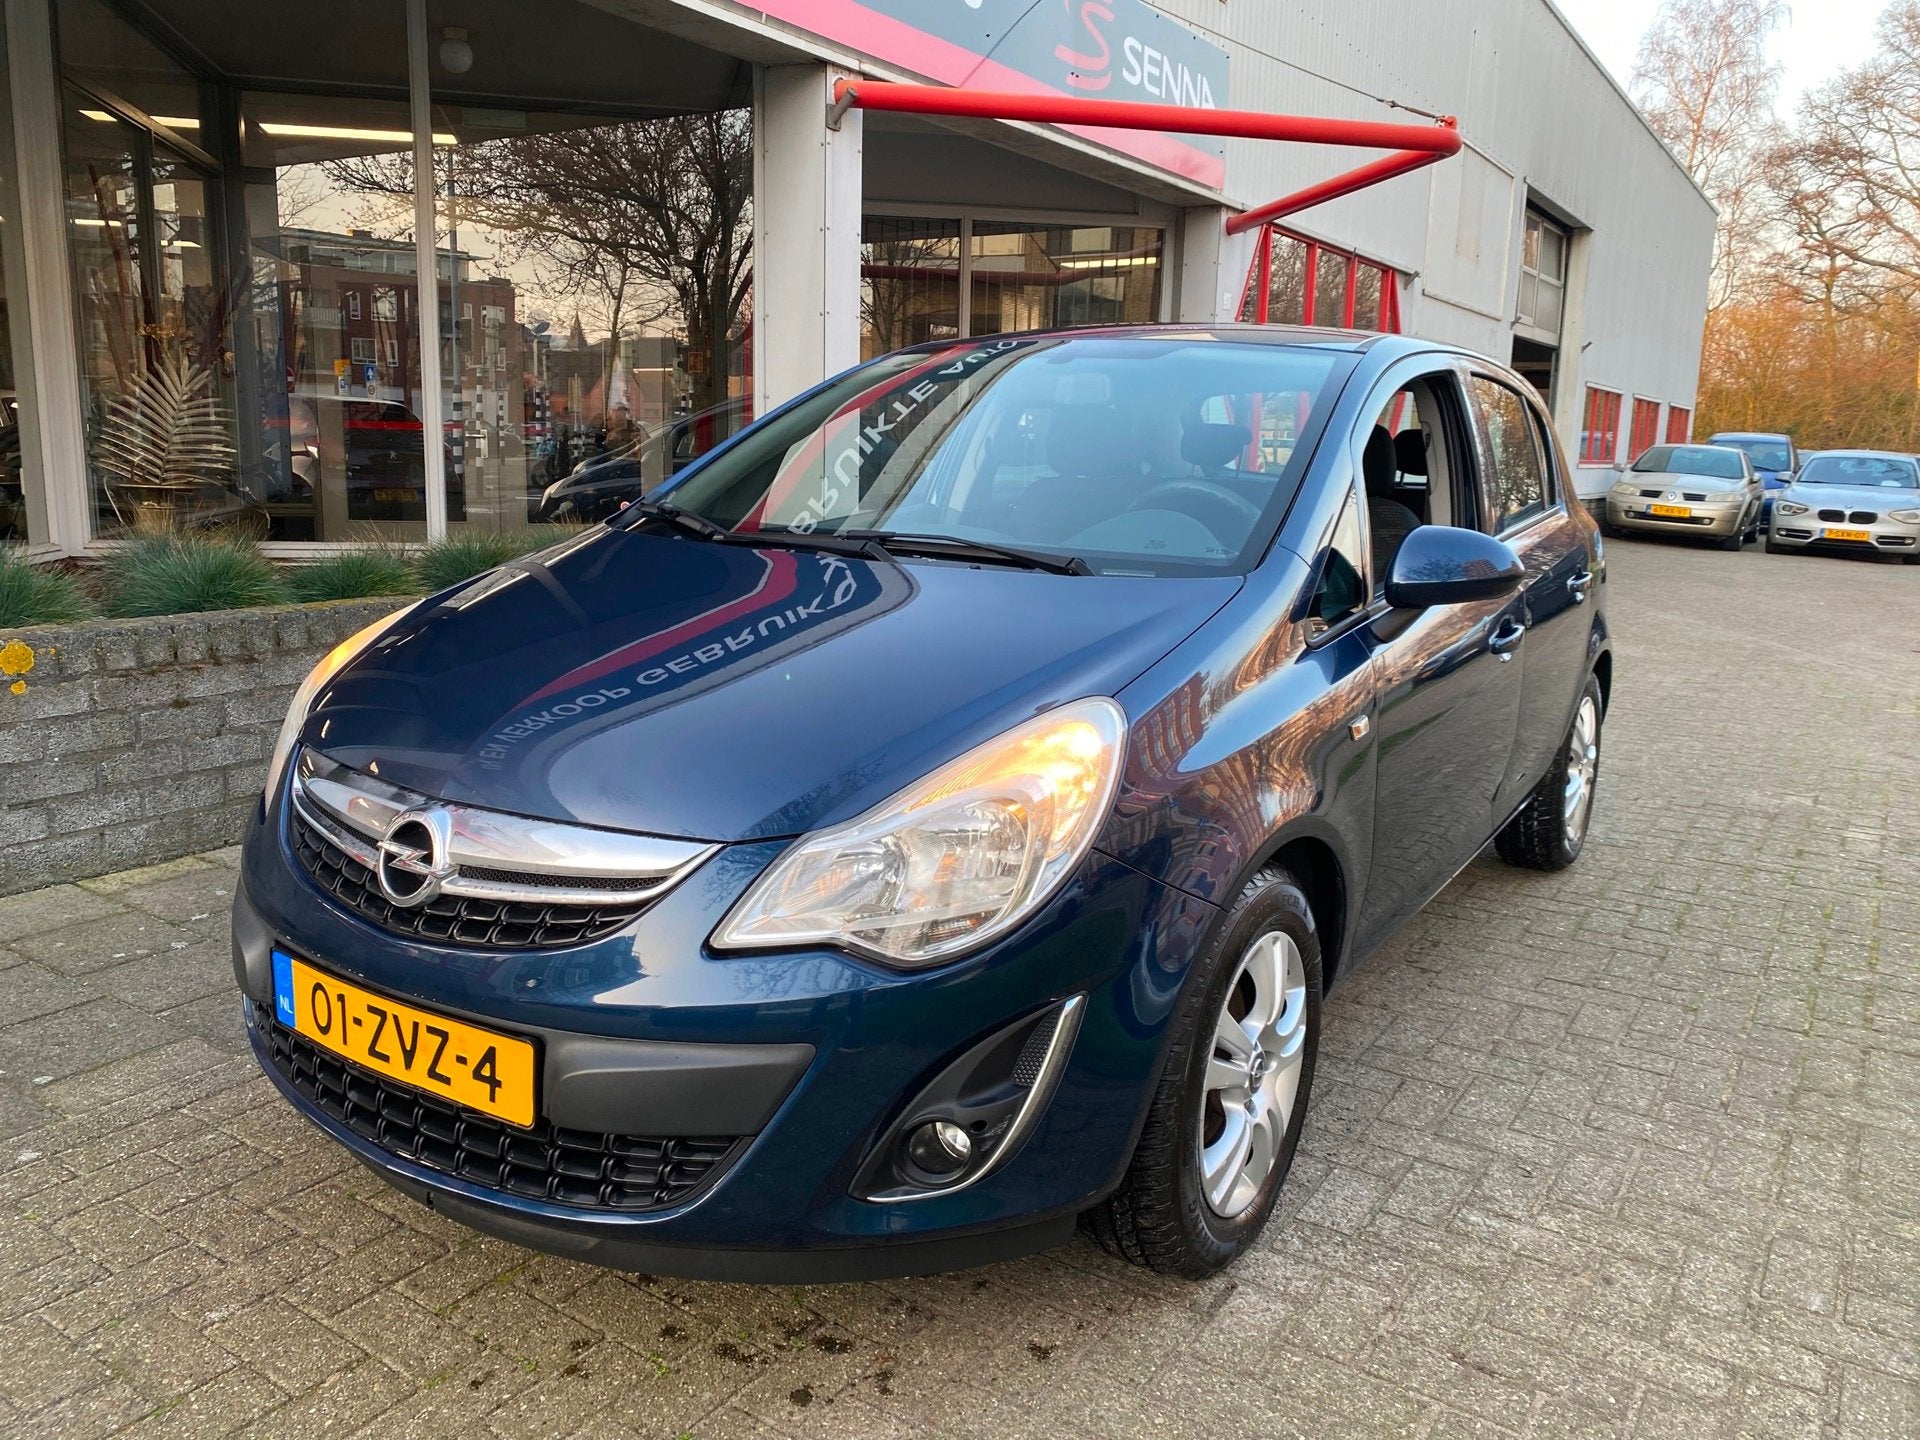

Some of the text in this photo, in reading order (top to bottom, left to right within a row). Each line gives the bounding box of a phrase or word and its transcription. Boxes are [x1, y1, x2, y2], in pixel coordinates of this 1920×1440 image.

[1122, 36, 1216, 109] SENNA
[280, 994, 293, 1014] NL
[311, 982, 502, 1103] 01-ZVZ-4
